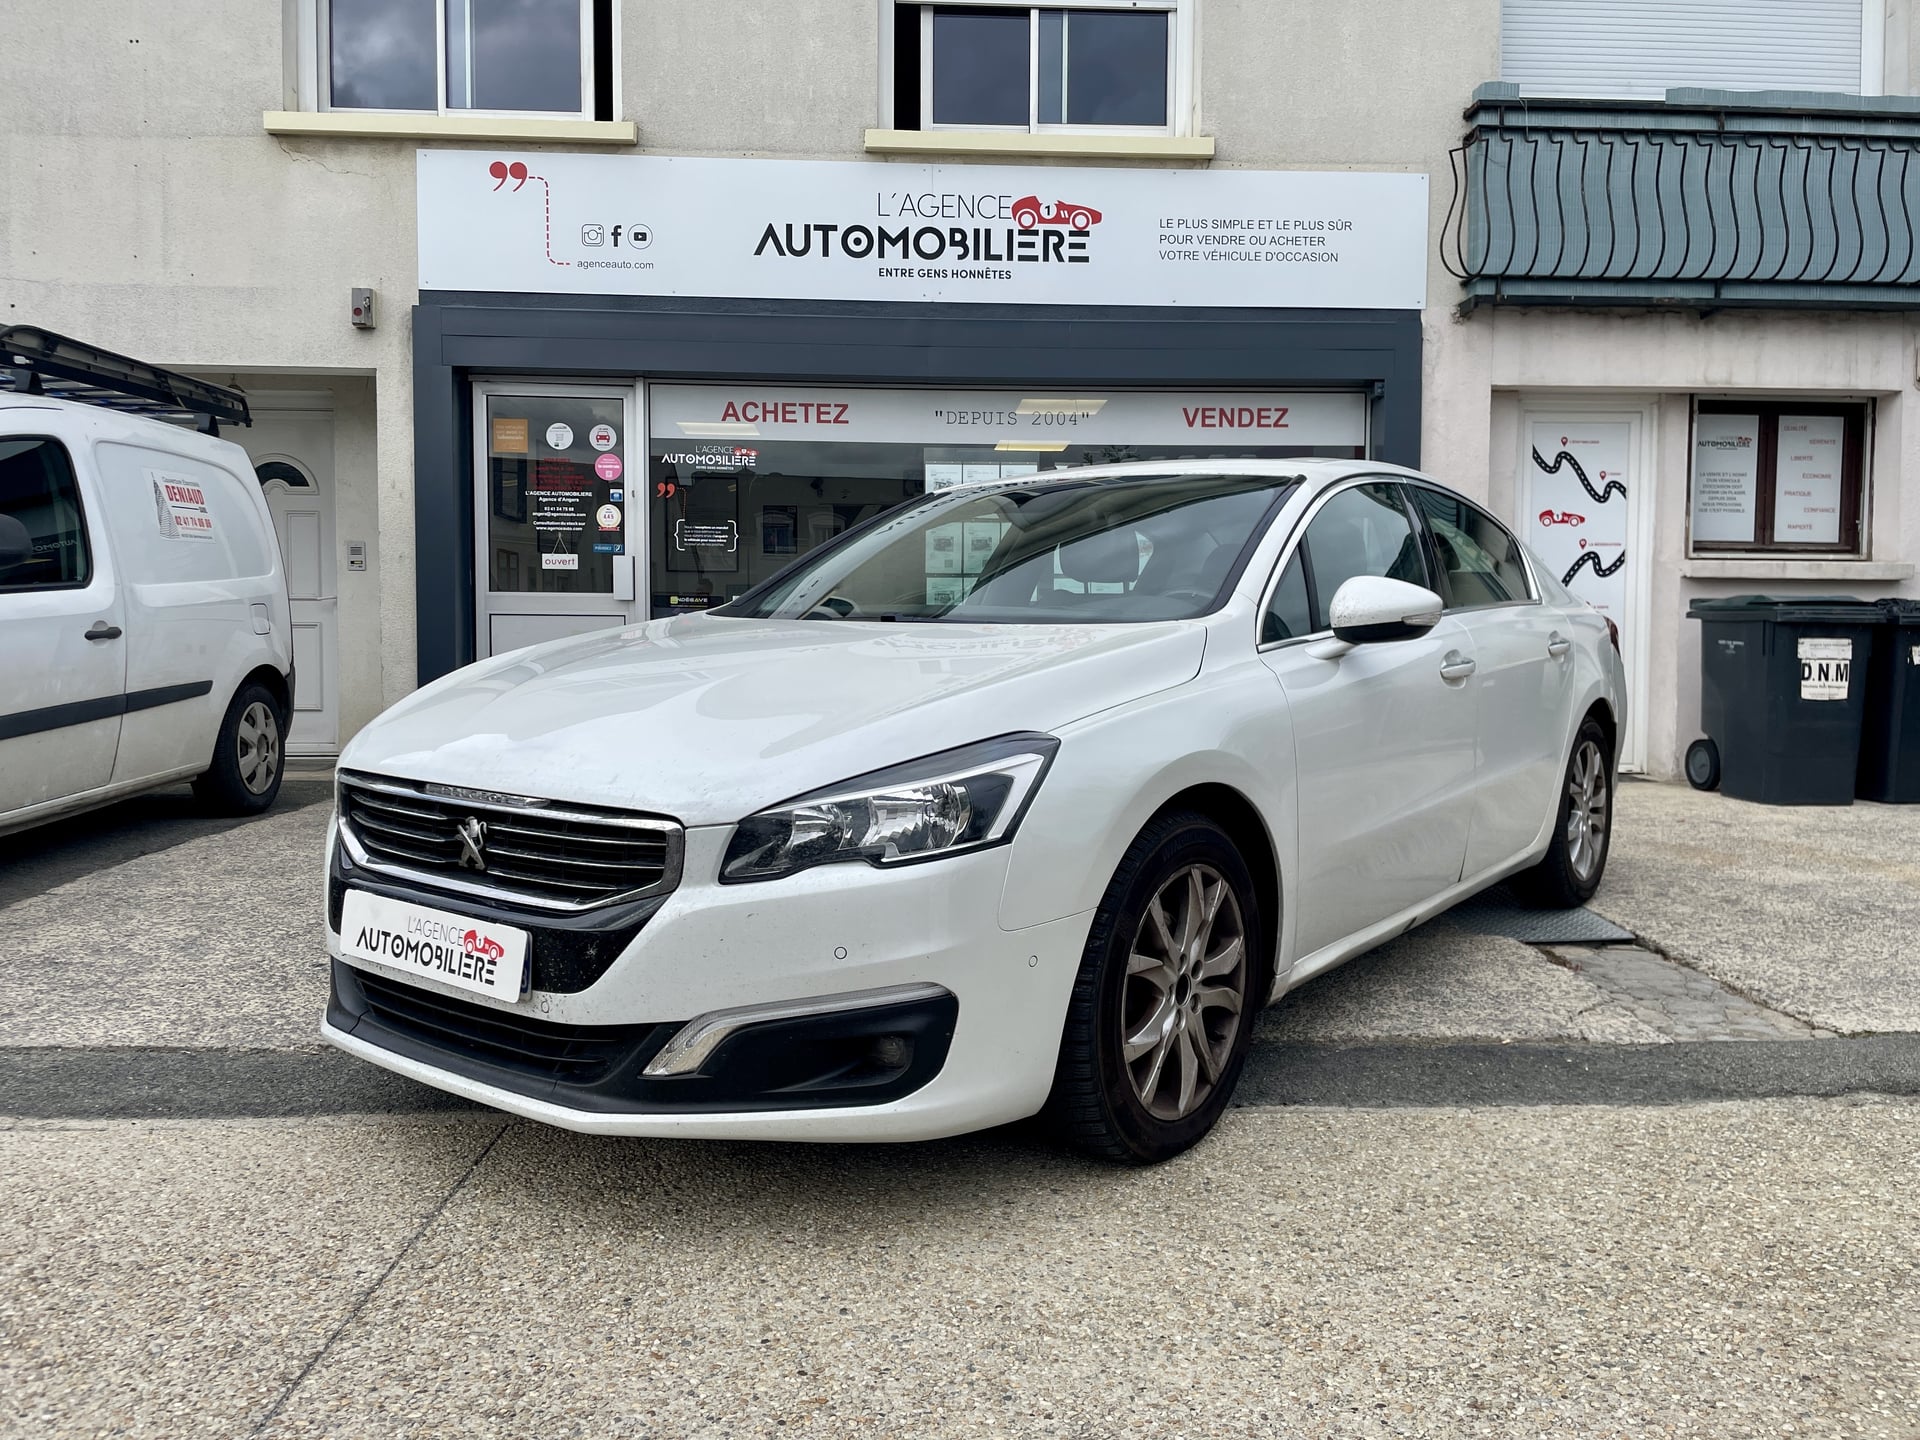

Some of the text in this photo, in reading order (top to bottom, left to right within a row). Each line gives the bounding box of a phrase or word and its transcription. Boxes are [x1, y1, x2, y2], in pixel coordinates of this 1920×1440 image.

[1159, 219, 1353, 231] LE PLUS SIMPLE ET LE PLUS SÛR
[1159, 234, 1326, 247] POUR VENDRE OU ACHETER
[1159, 249, 1339, 263] VOTRE VÉHICULE D'OCCASION
[577, 260, 654, 270] agenceauto.com
[879, 267, 1012, 280] ENTRE GENS HONNÊTES
[721, 401, 849, 424] ACHETEZ
[1182, 407, 1289, 428] VENDEZ
[165, 484, 205, 505] DENIAUD
[544, 558, 575, 566] ouvert
[407, 916, 465, 946] L'AGENCE
